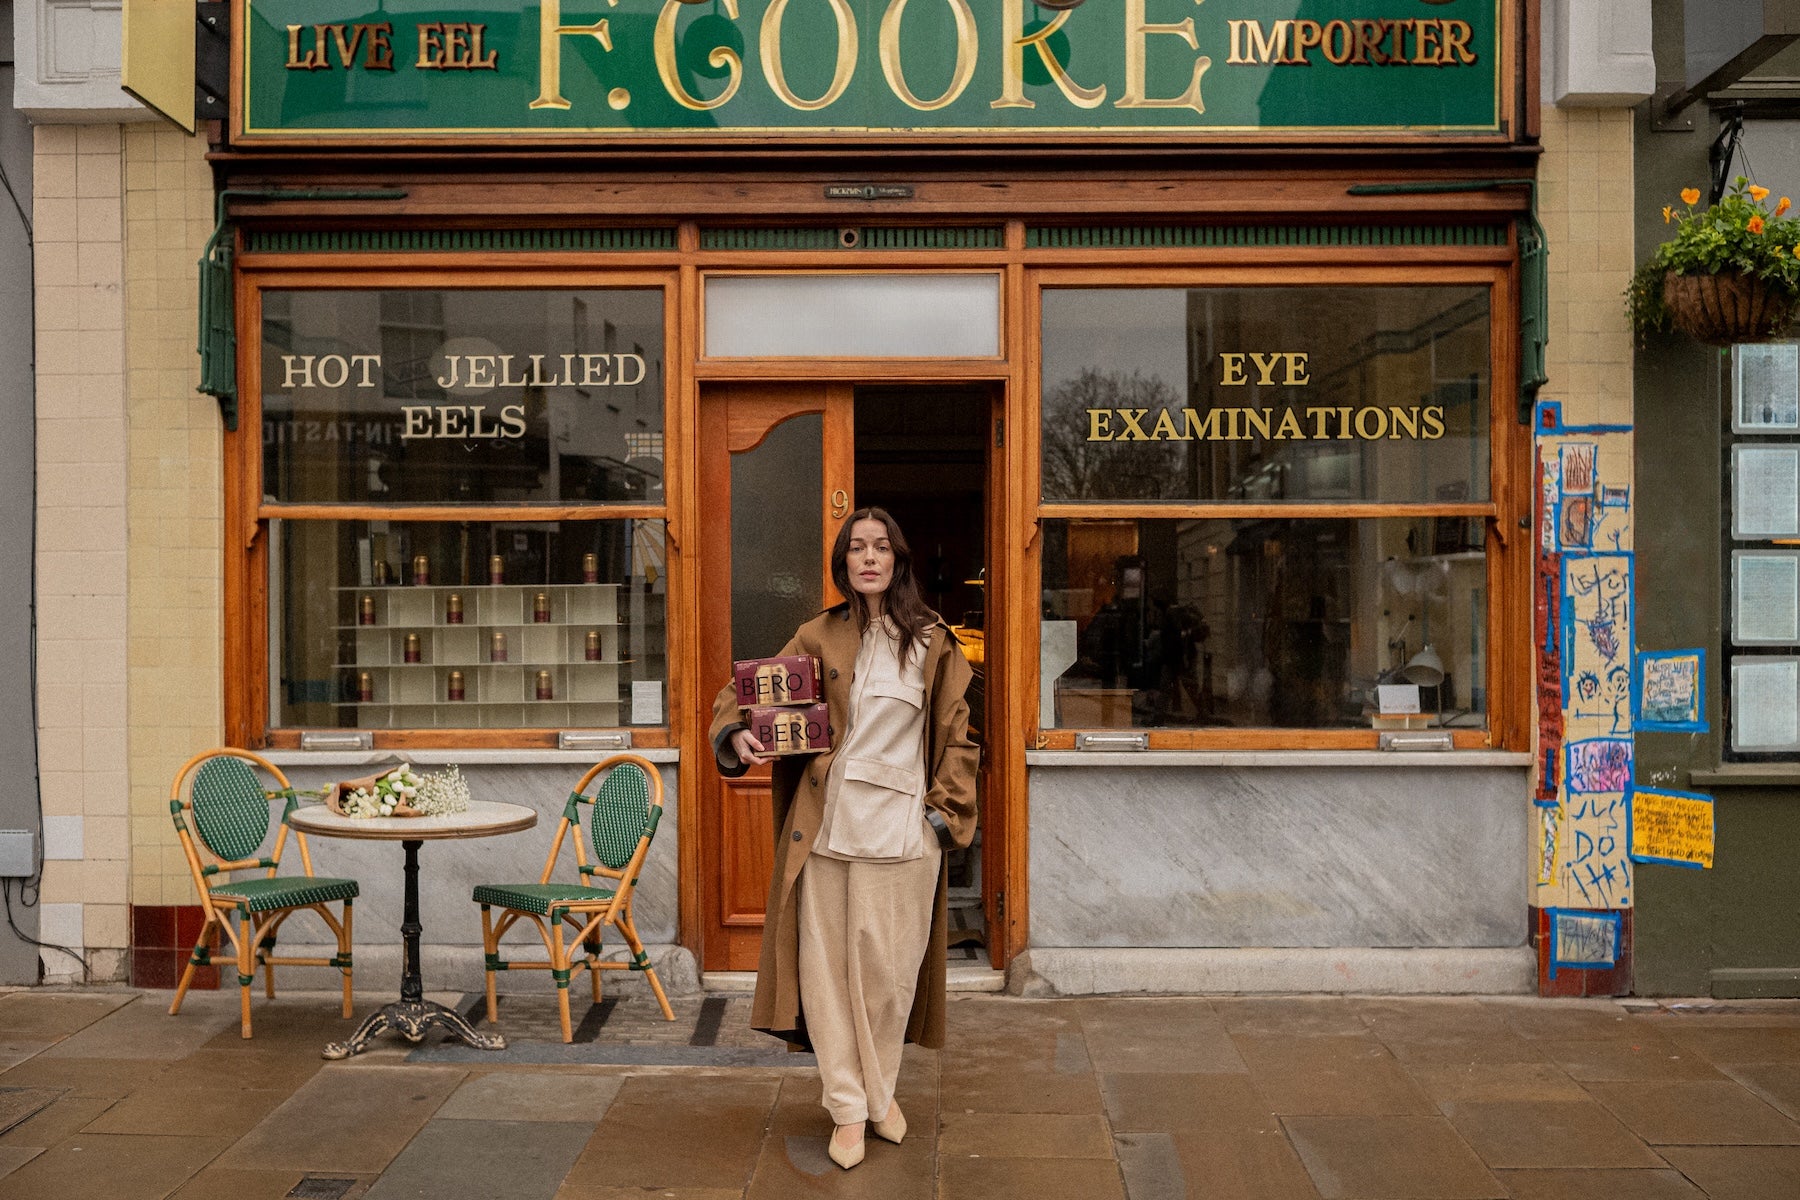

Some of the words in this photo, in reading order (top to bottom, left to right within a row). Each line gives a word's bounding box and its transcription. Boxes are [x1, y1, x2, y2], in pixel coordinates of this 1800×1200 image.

[285, 23, 395, 71] LIVE
[415, 22, 498, 71] EEL
[1226, 18, 1479, 67] IMPORTER
[280, 353, 382, 388] HOT
[437, 352, 647, 389] JELLIED
[1219, 351, 1312, 386] EYE
[400, 404, 527, 439] EELS
[1085, 405, 1446, 442] EXAMINATIONS
[830, 489, 849, 519] 9
[741, 673, 803, 697] BERO
[759, 721, 822, 744] BERO
